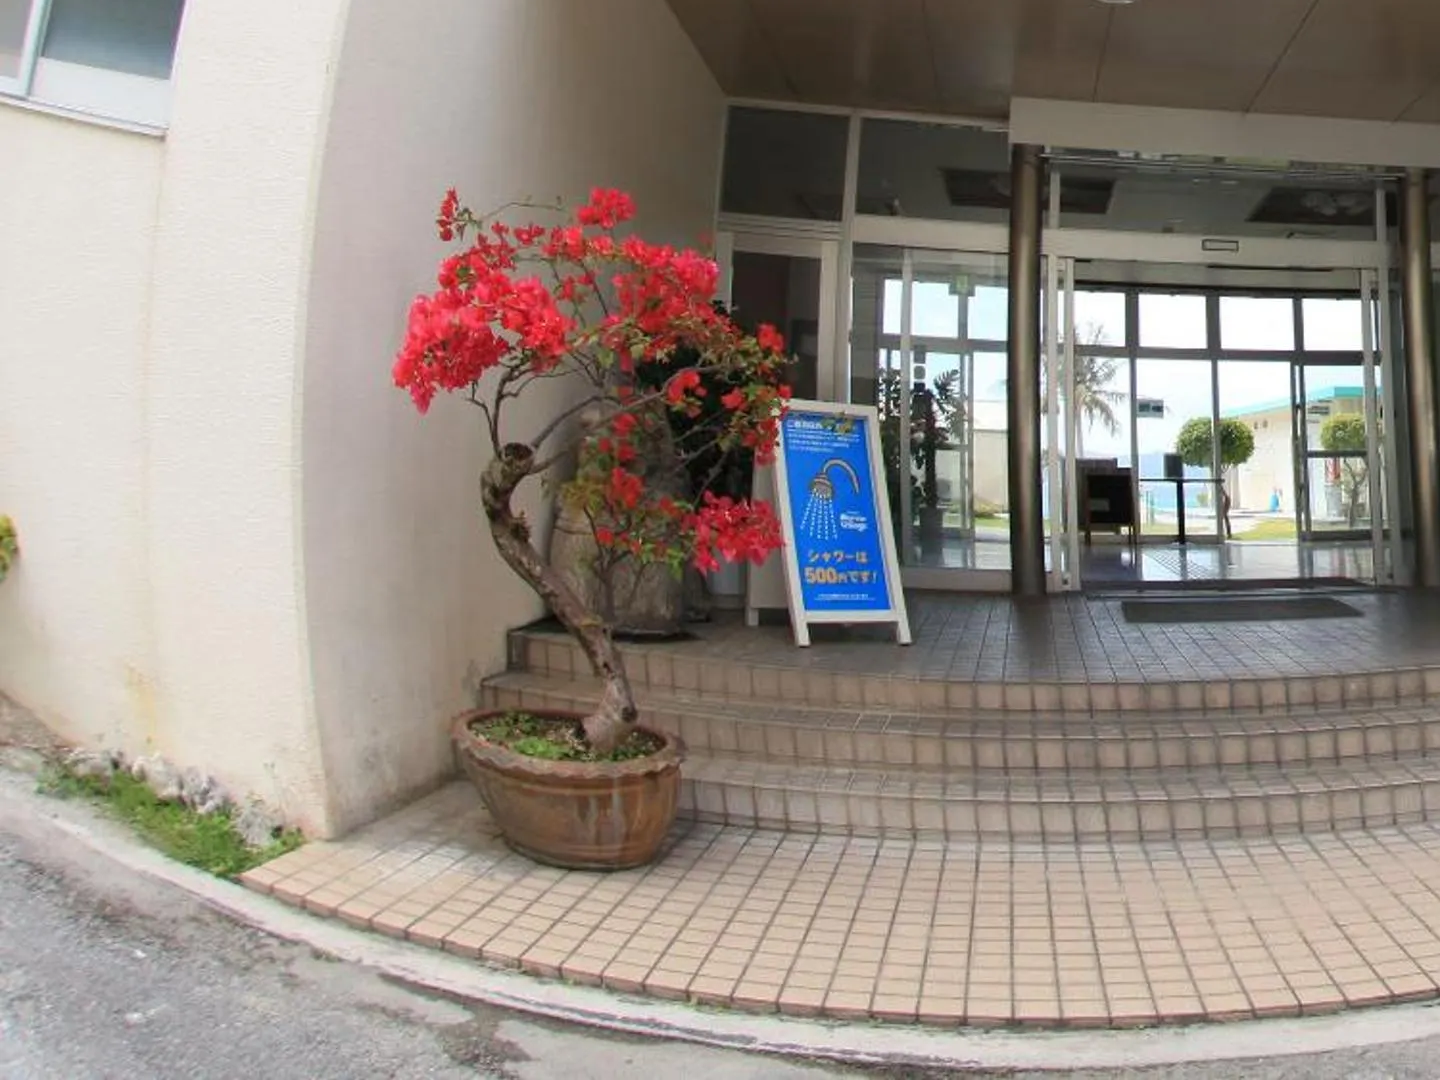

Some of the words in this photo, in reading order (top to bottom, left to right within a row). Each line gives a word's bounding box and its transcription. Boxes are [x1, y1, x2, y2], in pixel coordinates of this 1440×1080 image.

[807, 549, 868, 564] シャワーは
